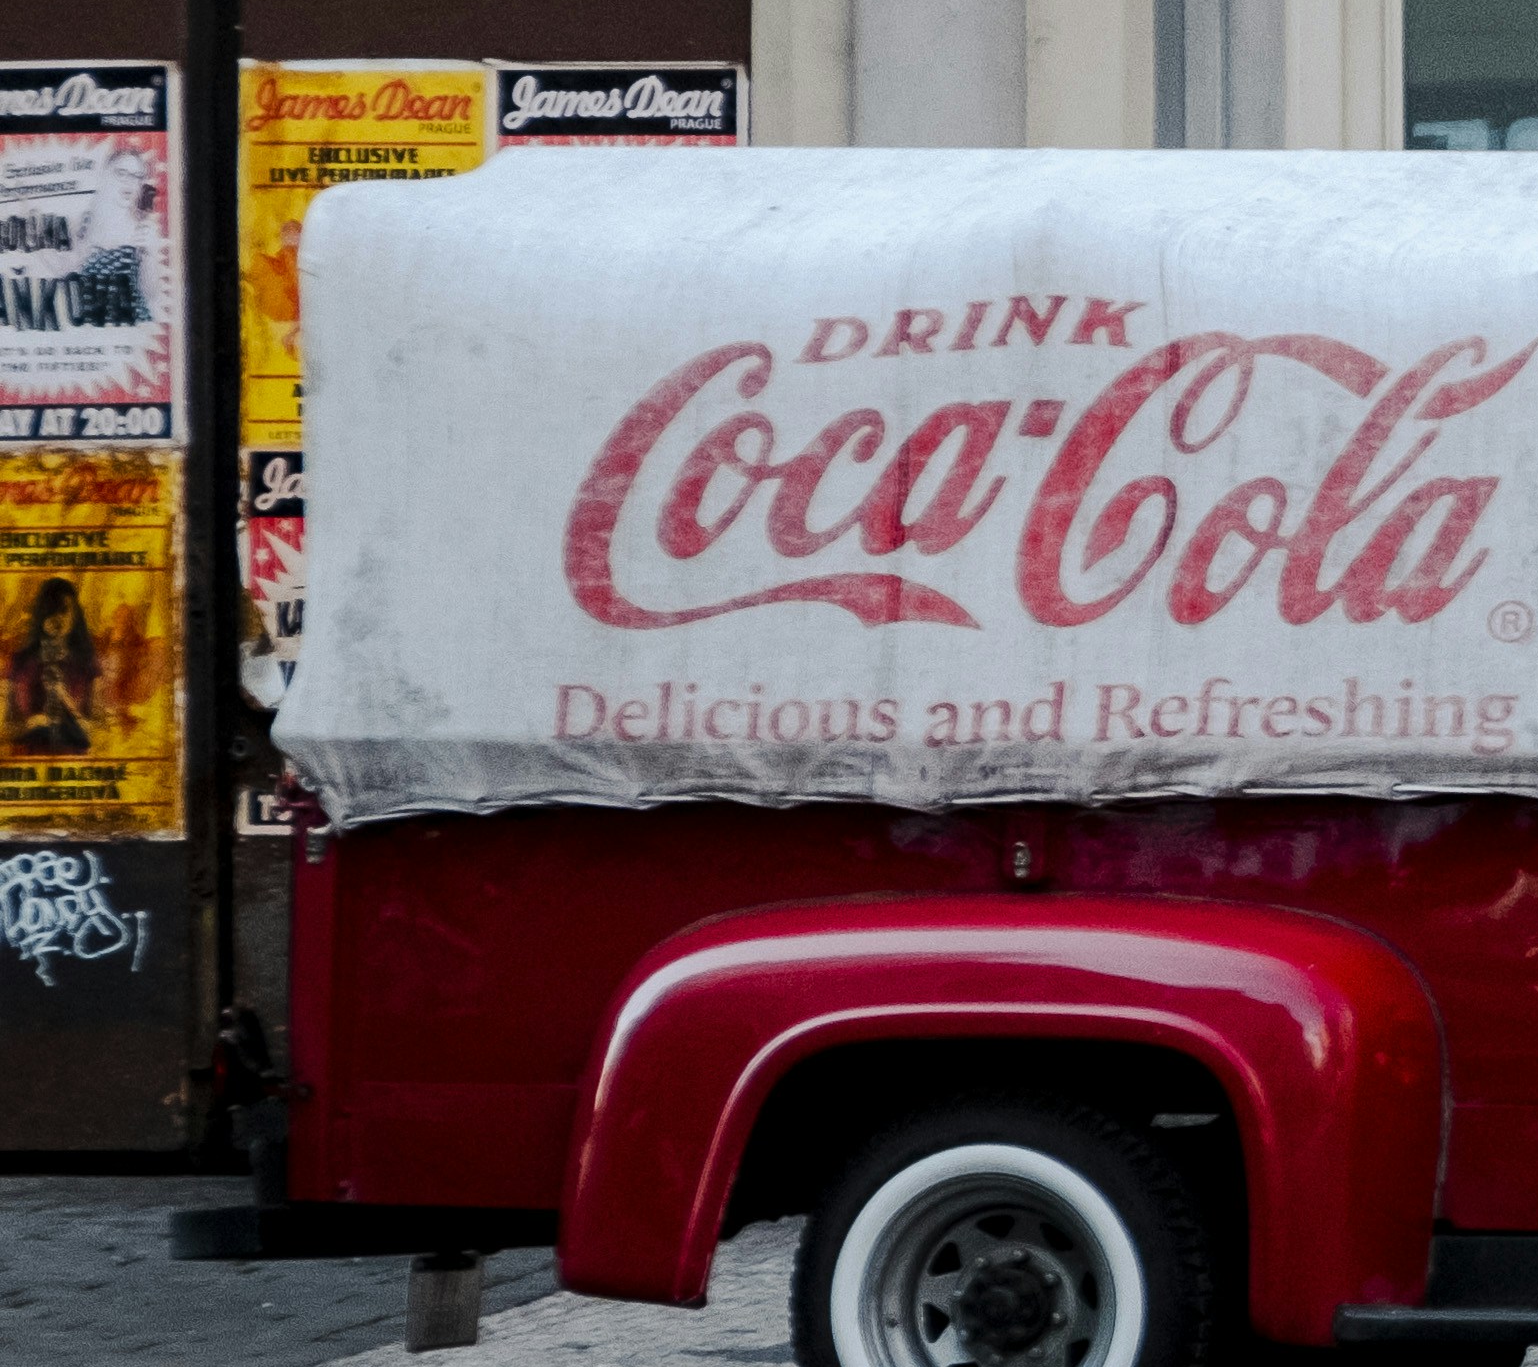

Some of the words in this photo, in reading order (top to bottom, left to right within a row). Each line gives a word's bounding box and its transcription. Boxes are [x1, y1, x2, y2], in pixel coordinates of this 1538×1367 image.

[247, 78, 366, 132] James
[372, 78, 473, 121] Dean
[503, 75, 625, 130] James
[623, 74, 724, 118] Dean
[670, 118, 722, 130] PRAGUE
[269, 168, 311, 183] LIVE
[307, 148, 419, 164] EXCLUSIVE
[794, 293, 1148, 364] DRINK
[80, 408, 162, 436] 20:00
[553, 681, 898, 746] Delicious
[925, 681, 1066, 747] and
[1092, 677, 1520, 755] Refreshing
